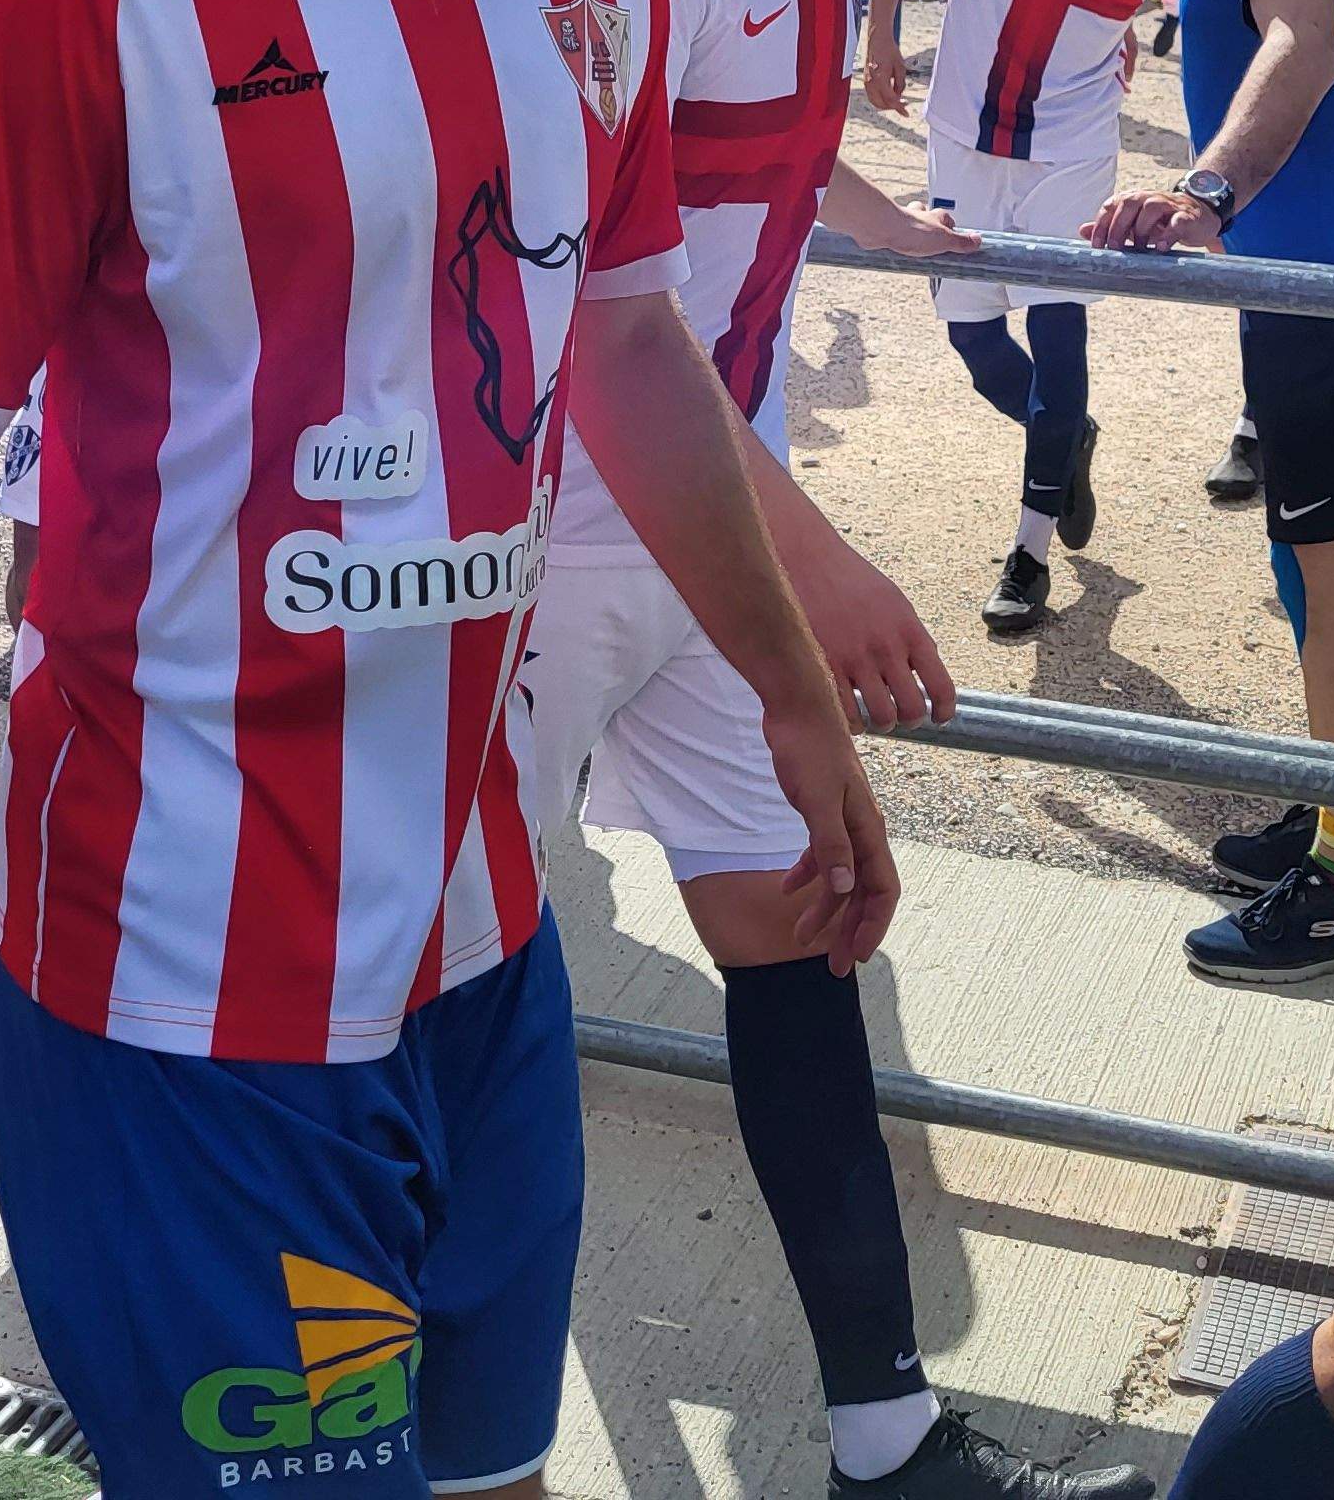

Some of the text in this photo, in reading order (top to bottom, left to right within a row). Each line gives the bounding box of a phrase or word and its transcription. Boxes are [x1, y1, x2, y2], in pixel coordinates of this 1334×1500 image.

[212, 71, 329, 105] MERCURY
[313, 430, 414, 482] vive!
[220, 1427, 413, 1489] BARBAST
